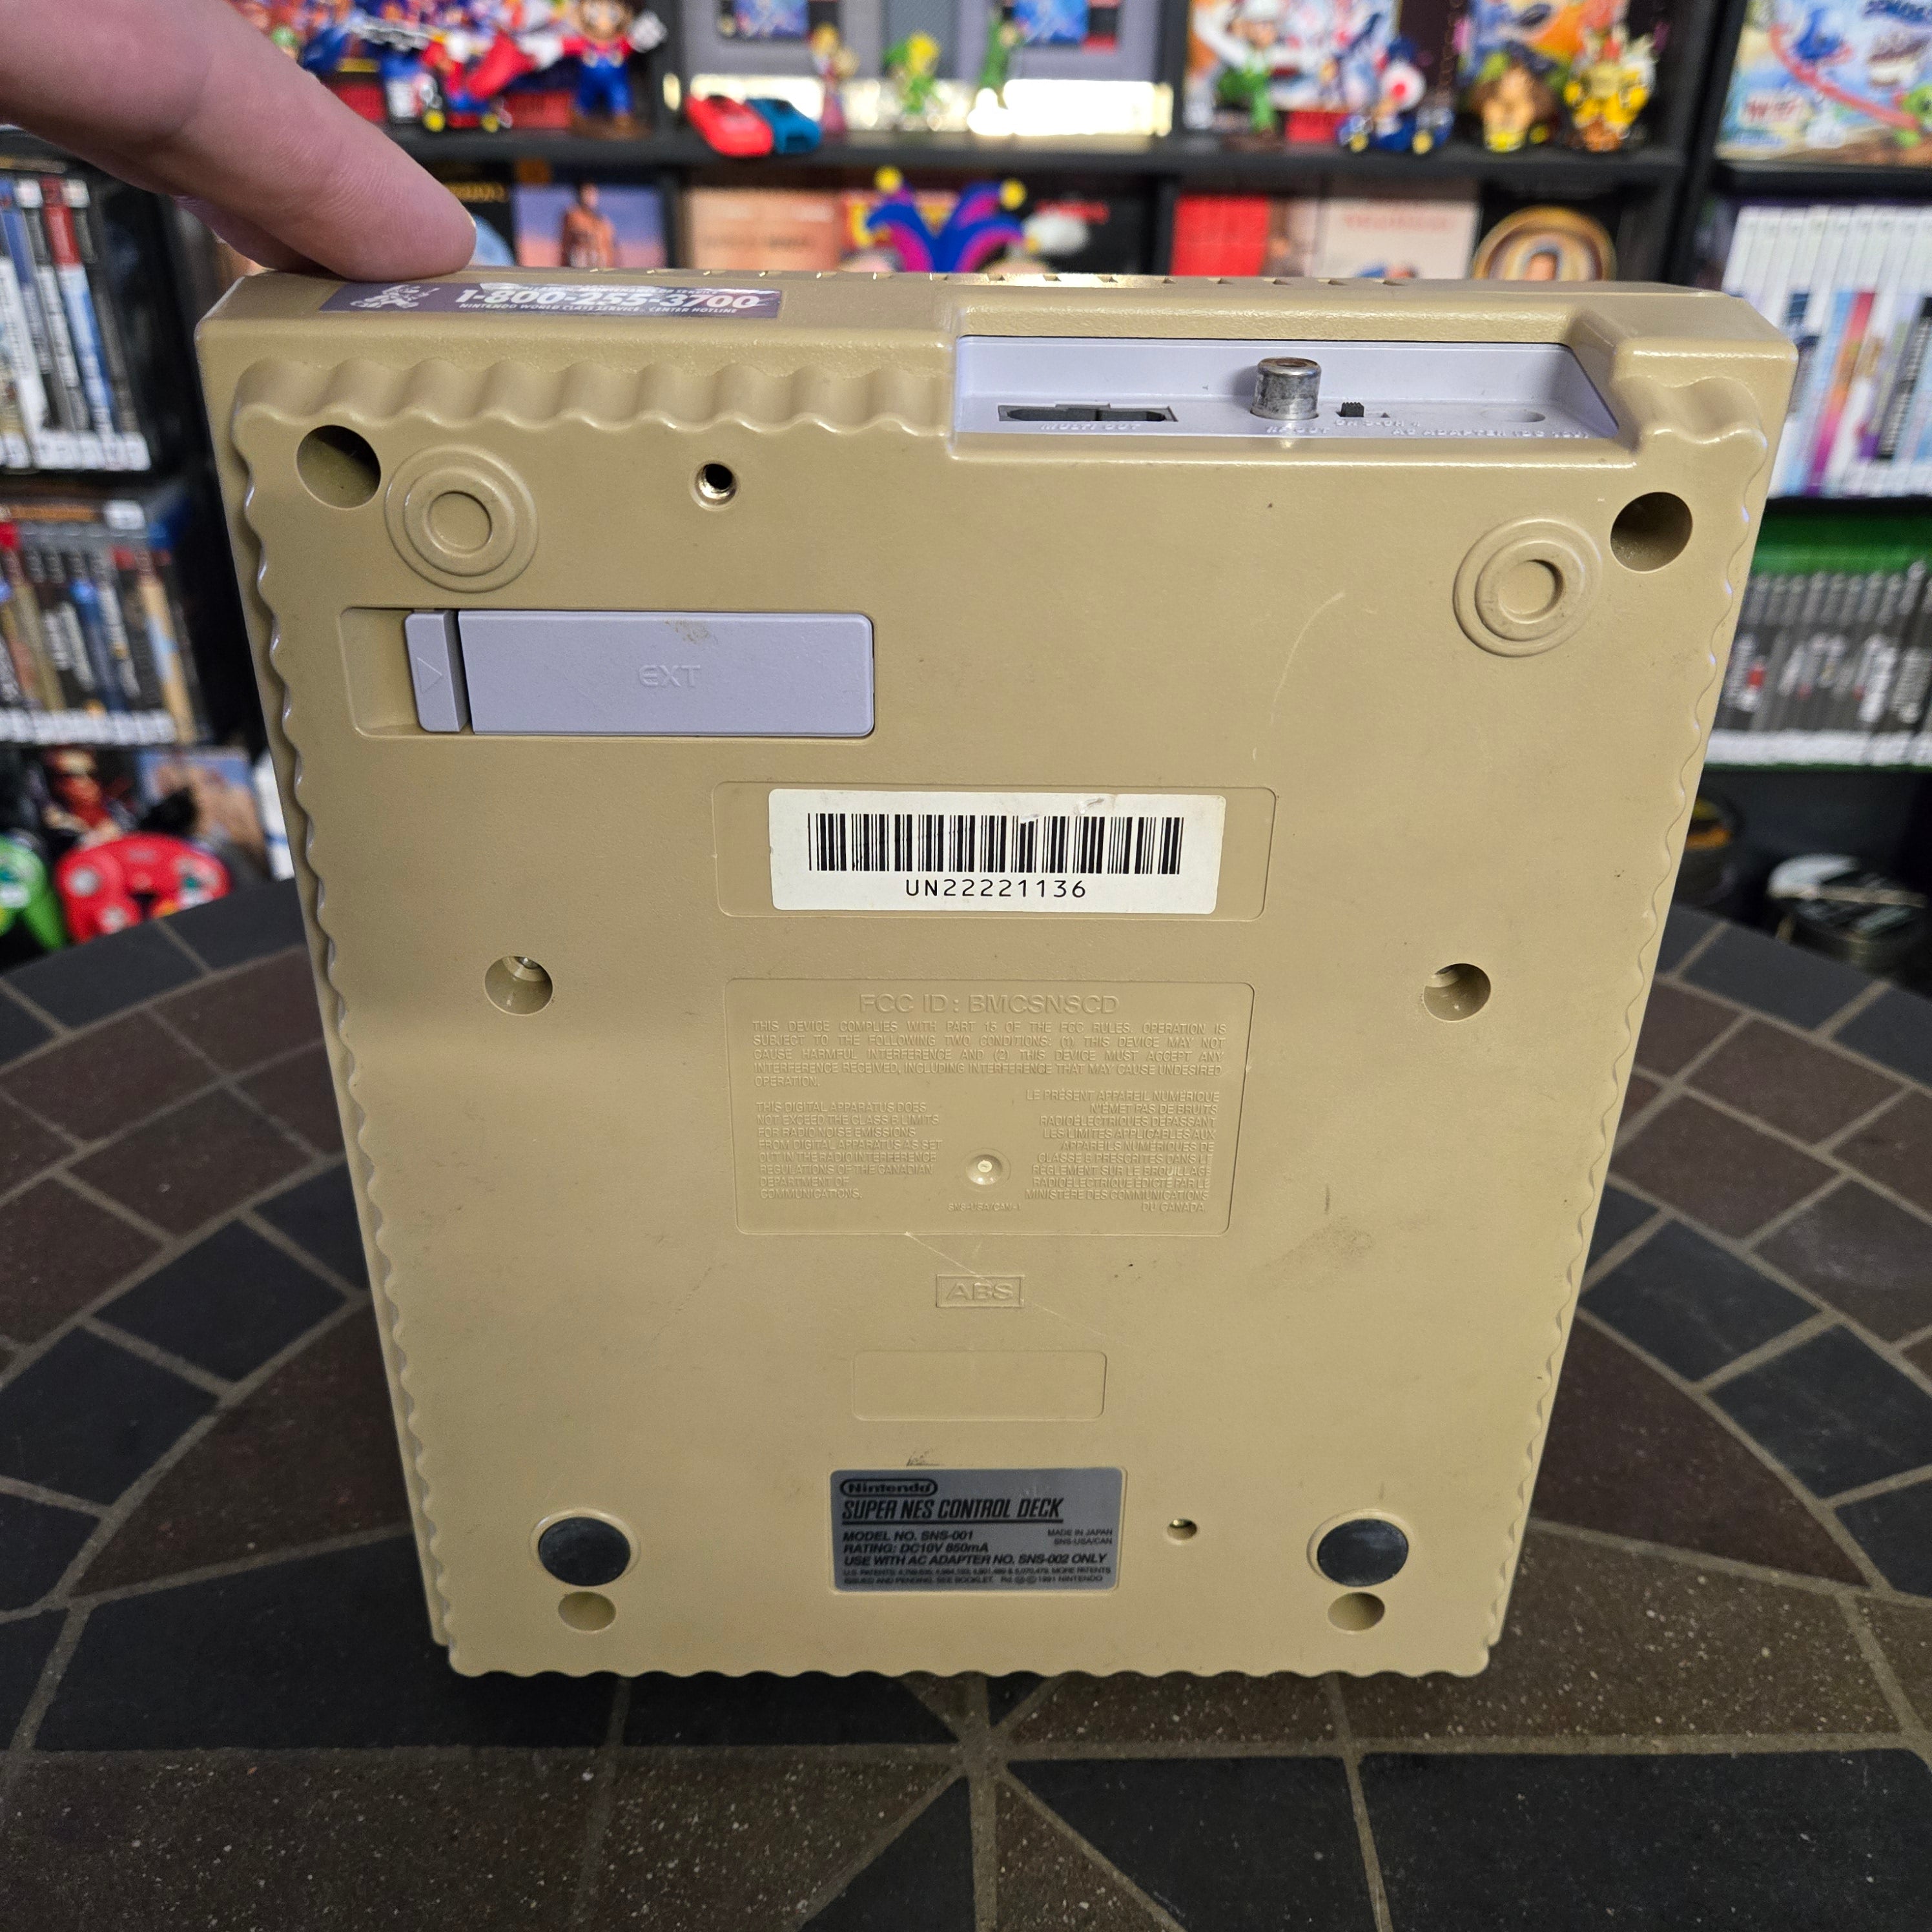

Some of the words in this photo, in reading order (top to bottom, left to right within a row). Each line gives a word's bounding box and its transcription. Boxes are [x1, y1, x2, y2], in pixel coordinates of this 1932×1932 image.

[455, 289, 760, 308] 1-800-255-3700
[639, 664, 701, 688] EXT
[906, 879, 1085, 898] UN22221136
[860, 994, 914, 1013] FCC
[969, 994, 1120, 1014] BMCSNSCD
[752, 1021, 779, 1032] THIS
[788, 1021, 830, 1032] DEVICE
[840, 1021, 898, 1033] COMPLIES
[906, 1022, 936, 1033] WITH
[947, 1022, 976, 1033] PART
[985, 1022, 997, 1033] 15
[1005, 1022, 1021, 1033] OF
[1030, 1022, 1052, 1033] THE
[1060, 1022, 1084, 1033] FCC
[1093, 1022, 1133, 1034] RULES.
[1142, 1023, 1206, 1034] OPERATION
[1215, 1023, 1227, 1034] IS
[752, 1035, 805, 1046] SUBJECT
[813, 1035, 829, 1047] TO
[838, 1035, 861, 1047] THE
[868, 1036, 936, 1047] FOLLOWING
[944, 1036, 971, 1047] TWO
[980, 1036, 1052, 1047] CONDITIONS:
[1060, 1036, 1074, 1047] (1)
[1084, 1036, 1110, 1048] THIS
[1118, 1036, 1160, 1048] DEVICE
[1167, 1037, 1194, 1048] MAY
[1201, 1037, 1226, 1048] NOT
[754, 1049, 792, 1060] CAUSE
[802, 1049, 858, 1060] HARMFUL
[868, 1049, 952, 1061] INTERFERENCE
[961, 1050, 985, 1061] AND
[993, 1050, 1009, 1061] (2)
[1020, 1050, 1045, 1062] THIS
[1054, 1050, 1096, 1062] DEVICE
[1104, 1051, 1139, 1062] MUST
[1146, 1051, 1193, 1062] ACCEPT
[1200, 1051, 1224, 1062] ANY
[754, 1062, 839, 1074] INTERFERENCE
[843, 1063, 901, 1074] RECEIVED,
[905, 1064, 965, 1074] INCLUDING
[969, 1064, 1053, 1075] INTERFERENCE
[1057, 1064, 1085, 1075] THAT
[1089, 1064, 1114, 1075] MAY
[1116, 1064, 1156, 1076] CAUSE
[1158, 1065, 1222, 1076] UNDESIRED
[755, 1076, 820, 1087] OPERATION.
[756, 1102, 782, 1113] THIS
[785, 1102, 827, 1113] DIGITAL
[831, 1102, 894, 1113] APPARATUS
[897, 1102, 927, 1113] DOES
[756, 1115, 779, 1125] NOT
[783, 1115, 825, 1125] EXCEED
[827, 1115, 848, 1125] THE
[852, 1115, 889, 1125] CLASS
[892, 1115, 898, 1125] B
[901, 1115, 939, 1125] LIMITS
[758, 1127, 779, 1138] FOR
[783, 1127, 816, 1138] RADIO
[820, 1127, 852, 1138] NOISE
[854, 1127, 916, 1138] EMISSIONS
[759, 1140, 790, 1150] FROM
[794, 1140, 836, 1150] DIGITAL
[837, 1140, 901, 1150] APPARATUS
[904, 1140, 919, 1150] AS
[921, 1140, 943, 1150] SET
[759, 1152, 781, 1162] OUT
[784, 1152, 794, 1162] IN
[797, 1152, 817, 1162] THE
[820, 1152, 853, 1162] RADIO
[855, 1152, 937, 1162] INTERFERENCE
[760, 1164, 834, 1175] REGULATIONS
[838, 1164, 852, 1175] OF
[854, 1164, 876, 1175] THE
[878, 1164, 933, 1175] CANADIAN
[760, 1177, 832, 1187] DEPARTMENT
[836, 1177, 850, 1187] OF
[761, 1189, 863, 1199] COMMUNICATIONS.
[946, 1282, 1013, 1300] ABS
[848, 1483, 930, 1494] Nintendo
[843, 1499, 896, 1519] SUPER
[901, 1499, 934, 1519] NES
[938, 1498, 1011, 1519] CONTROL
[1017, 1497, 1064, 1518] DECK
[843, 1530, 890, 1542] MODEL
[894, 1530, 917, 1542] NO.
[921, 1530, 973, 1541] SNS-001
[843, 1543, 897, 1554] RATING:
[945, 1543, 989, 1553] 850mA
[844, 1555, 871, 1567] USE
[874, 1555, 905, 1566] WITH
[908, 1555, 927, 1566] AC
[929, 1555, 991, 1565] ADAPTER
[992, 1554, 1015, 1565] NO.
[1018, 1554, 1069, 1565] SNS-002
[1072, 1553, 1108, 1564] ONLY
